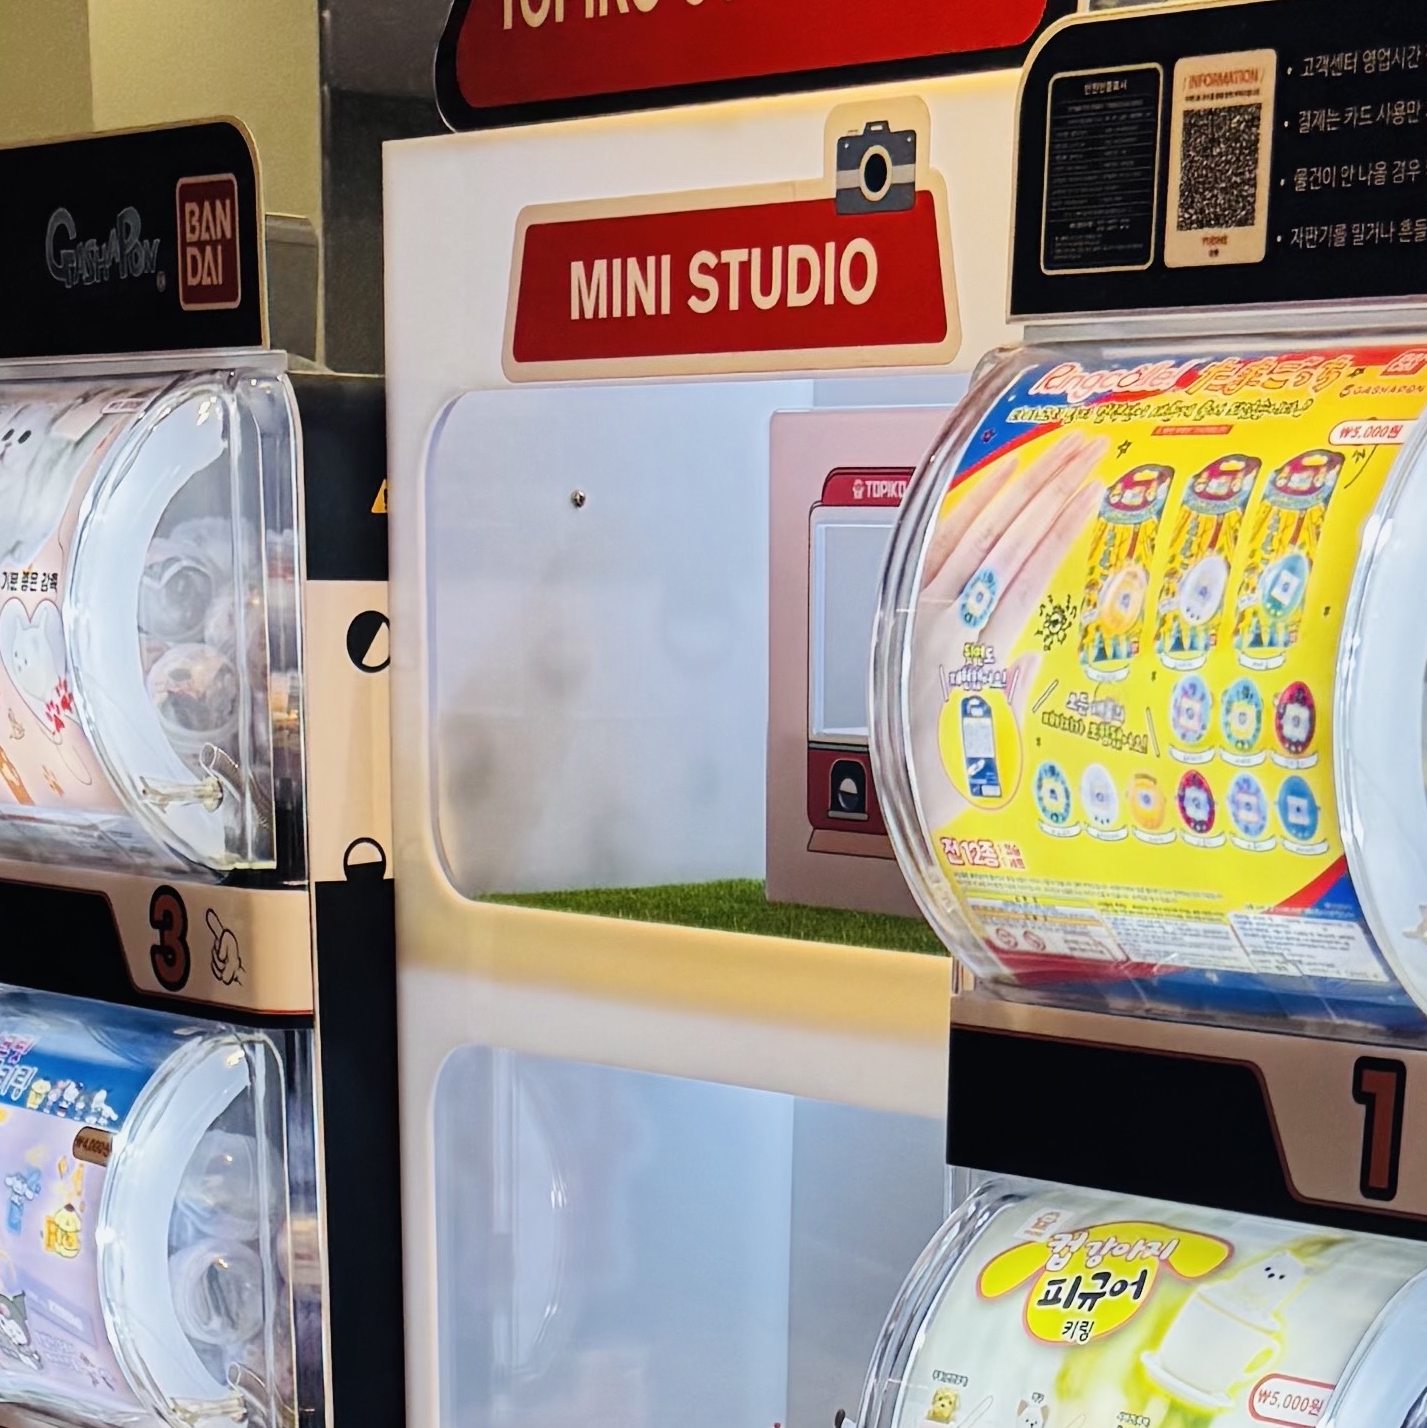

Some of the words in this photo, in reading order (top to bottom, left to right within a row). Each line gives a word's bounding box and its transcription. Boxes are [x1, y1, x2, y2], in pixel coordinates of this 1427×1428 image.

[1188, 69, 1259, 90] INFORMATION
[1300, 57, 1358, 78] 고객센터
[1362, 46, 1421, 74] 영업시간
[1344, 105, 1373, 129] 카드
[1376, 99, 1421, 126] 사용만
[1294, 166, 1336, 191] 물건이
[1357, 161, 1387, 187] 나올
[184, 198, 234, 240] BAN
[1351, 219, 1396, 246] 밀거나
[185, 243, 225, 288] DAI
[569, 253, 672, 320] MINI
[687, 236, 878, 314] STUDIO
[864, 479, 907, 499] TOPIKO
[149, 885, 191, 992] 3
[1352, 1056, 1407, 1202] 1
[1042, 1233, 1079, 1271] 컵
[1083, 1236, 1180, 1267] 강아지
[1036, 1270, 1150, 1311] 피규어
[1061, 1319, 1094, 1344] 키링
